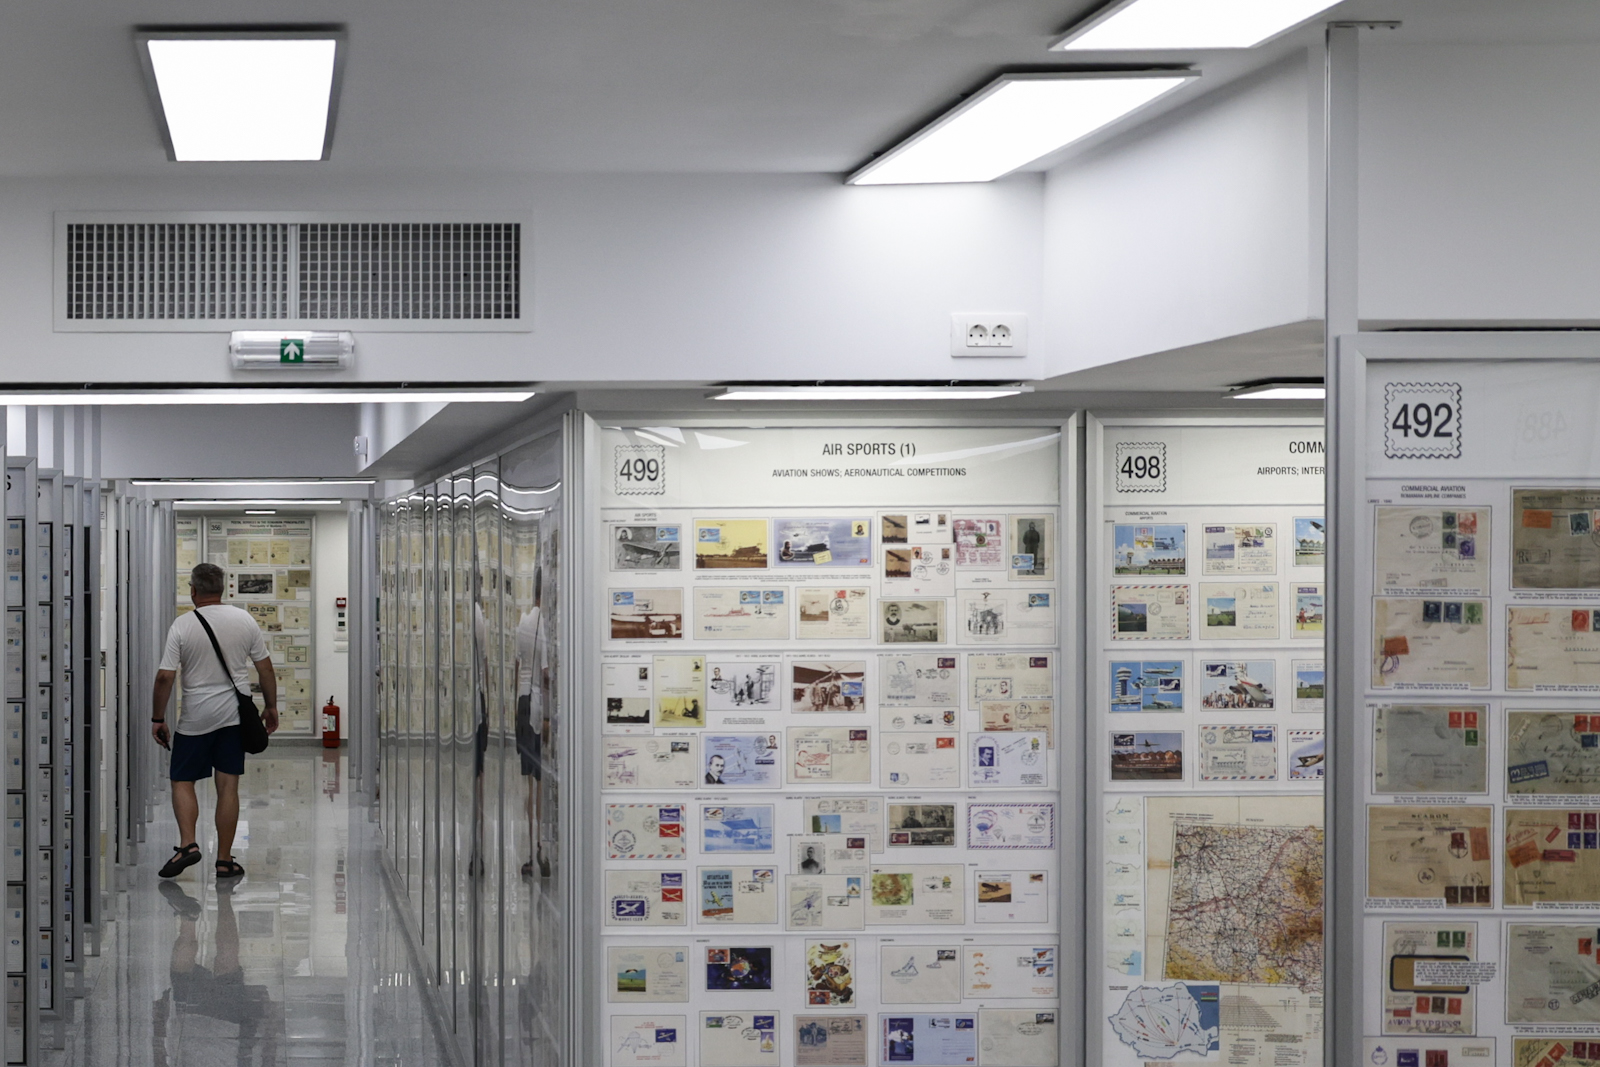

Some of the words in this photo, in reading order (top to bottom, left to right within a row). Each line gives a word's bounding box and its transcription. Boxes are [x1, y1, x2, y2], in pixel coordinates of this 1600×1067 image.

[1392, 402, 1453, 438] 492
[822, 443, 843, 456] AIR
[846, 442, 896, 456] SPORTS
[899, 442, 916, 458] (1)
[619, 458, 660, 482] 499
[772, 468, 808, 478] AVIATION
[810, 468, 842, 479] SHOWS;
[843, 468, 905, 477] AERONAUTICAL
[906, 467, 967, 477] COMPETITIONS
[1120, 455, 1161, 479] 498
[1256, 466, 1300, 477] AIRPORTS;
